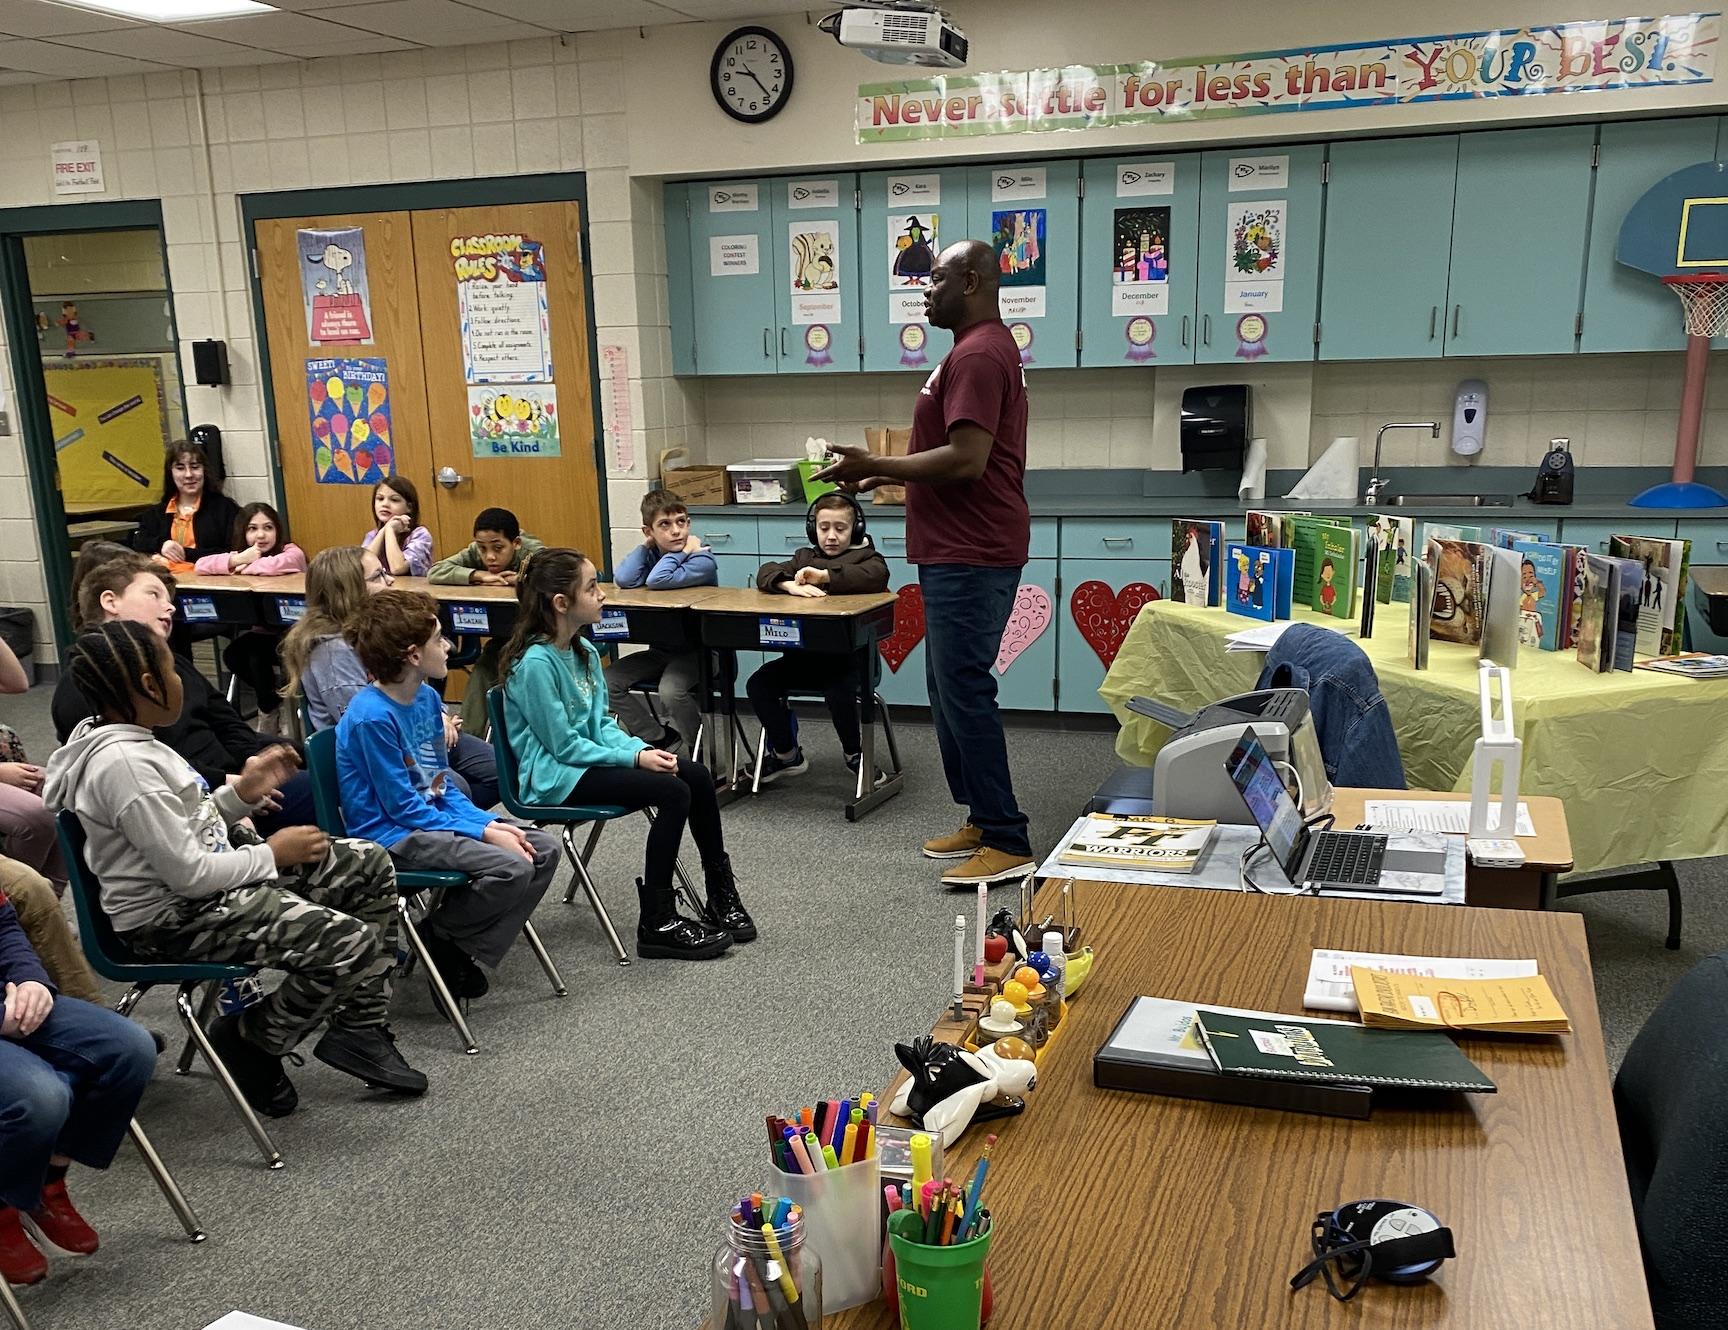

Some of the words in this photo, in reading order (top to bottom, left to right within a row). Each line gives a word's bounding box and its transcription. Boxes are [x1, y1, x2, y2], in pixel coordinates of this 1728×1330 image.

[735, 45, 743, 55] 11
[746, 40, 757, 50] 12
[763, 43, 767, 53] 1
[726, 57, 736, 67] 10
[770, 53, 778, 63] 2
[723, 72, 731, 81] 9
[773, 69, 782, 79] 3
[771, 83, 779, 93] 4
[872, 93, 983, 126] Never
[1123, 75, 1183, 108] for
[1194, 70, 1272, 103] less
[1285, 60, 1387, 95] than
[1404, 40, 1552, 91] YOUR
[727, 86, 736, 96] 8
[737, 97, 744, 107] 7
[762, 96, 771, 105] 5
[749, 101, 757, 111] 6
[55, 162, 75, 174] FIRE
[76, 161, 96, 173] EXIT
[451, 234, 523, 257] CLASSROOM
[454, 256, 498, 281] RULES
[1121, 291, 1159, 300] December
[1239, 290, 1269, 299] January
[901, 300, 925, 308] Octobe
[1001, 296, 1037, 304] November
[491, 441, 508, 453] Be
[511, 440, 540, 453] Kind
[1083, 843, 1190, 858] WARRIORS
